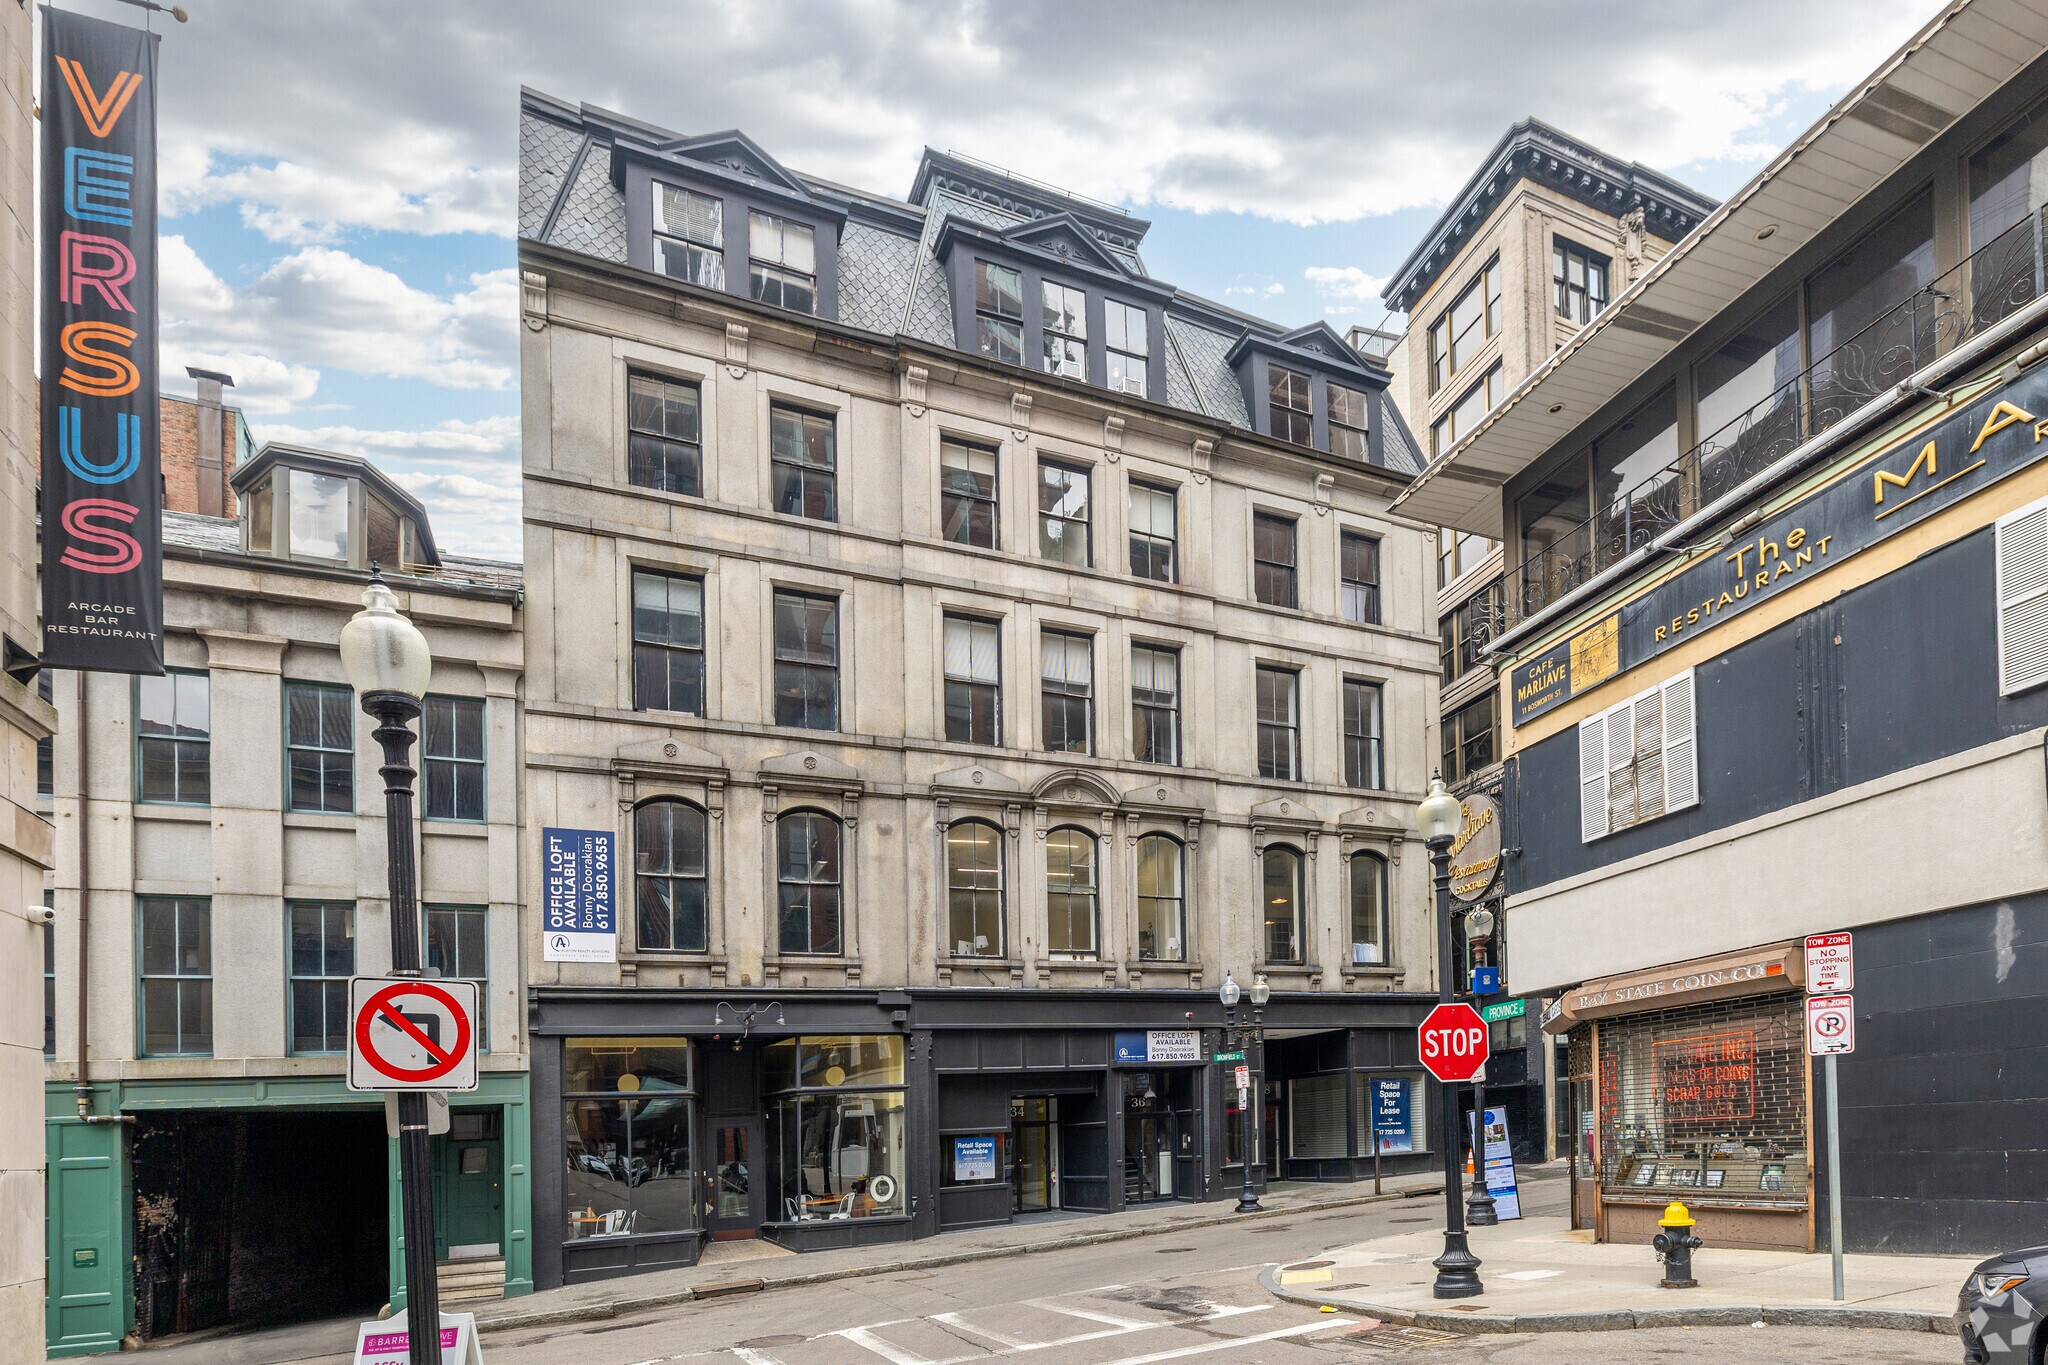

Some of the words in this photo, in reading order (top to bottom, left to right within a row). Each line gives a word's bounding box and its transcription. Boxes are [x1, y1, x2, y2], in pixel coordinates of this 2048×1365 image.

[54, 54, 143, 575] VERSUS
[1726, 527, 1807, 579] The
[1654, 535, 1832, 643] RESTAURANT
[67, 602, 136, 615] ARCADE
[85, 615, 118, 625] BAR
[47, 625, 158, 640] RESTAURANT
[1529, 657, 1554, 678] CAFE
[1518, 664, 1566, 702] MARLIAVE
[1528, 693, 1553, 712] BOSWORTH
[550, 836, 563, 872] LOFT
[581, 837, 593, 892] Doorakian
[564, 852, 576, 928] AVAILABLE
[596, 837, 608, 929] 617.850.9655
[1455, 877, 1488, 896] COCKTAILS
[551, 877, 563, 928] OFFICE
[582, 894, 596, 929] Bonny
[1808, 938, 1824, 946] TOW
[1827, 935, 1849, 945] ZONE
[1809, 956, 1850, 966] STOPPING
[1820, 949, 1837, 957] NO
[1579, 993, 1608, 1008] BAY
[1615, 981, 1664, 1002] STATE
[1672, 971, 1723, 991] COIN
[1489, 1003, 1518, 1019] PROVINCE
[1830, 998, 1850, 1006] ZONE
[1425, 1028, 1483, 1058] STOP
[1131, 1097, 1146, 1107] 36
[1379, 1091, 1401, 1099] Space
[1384, 1099, 1396, 1107] For
[1010, 1106, 1025, 1117] 34
